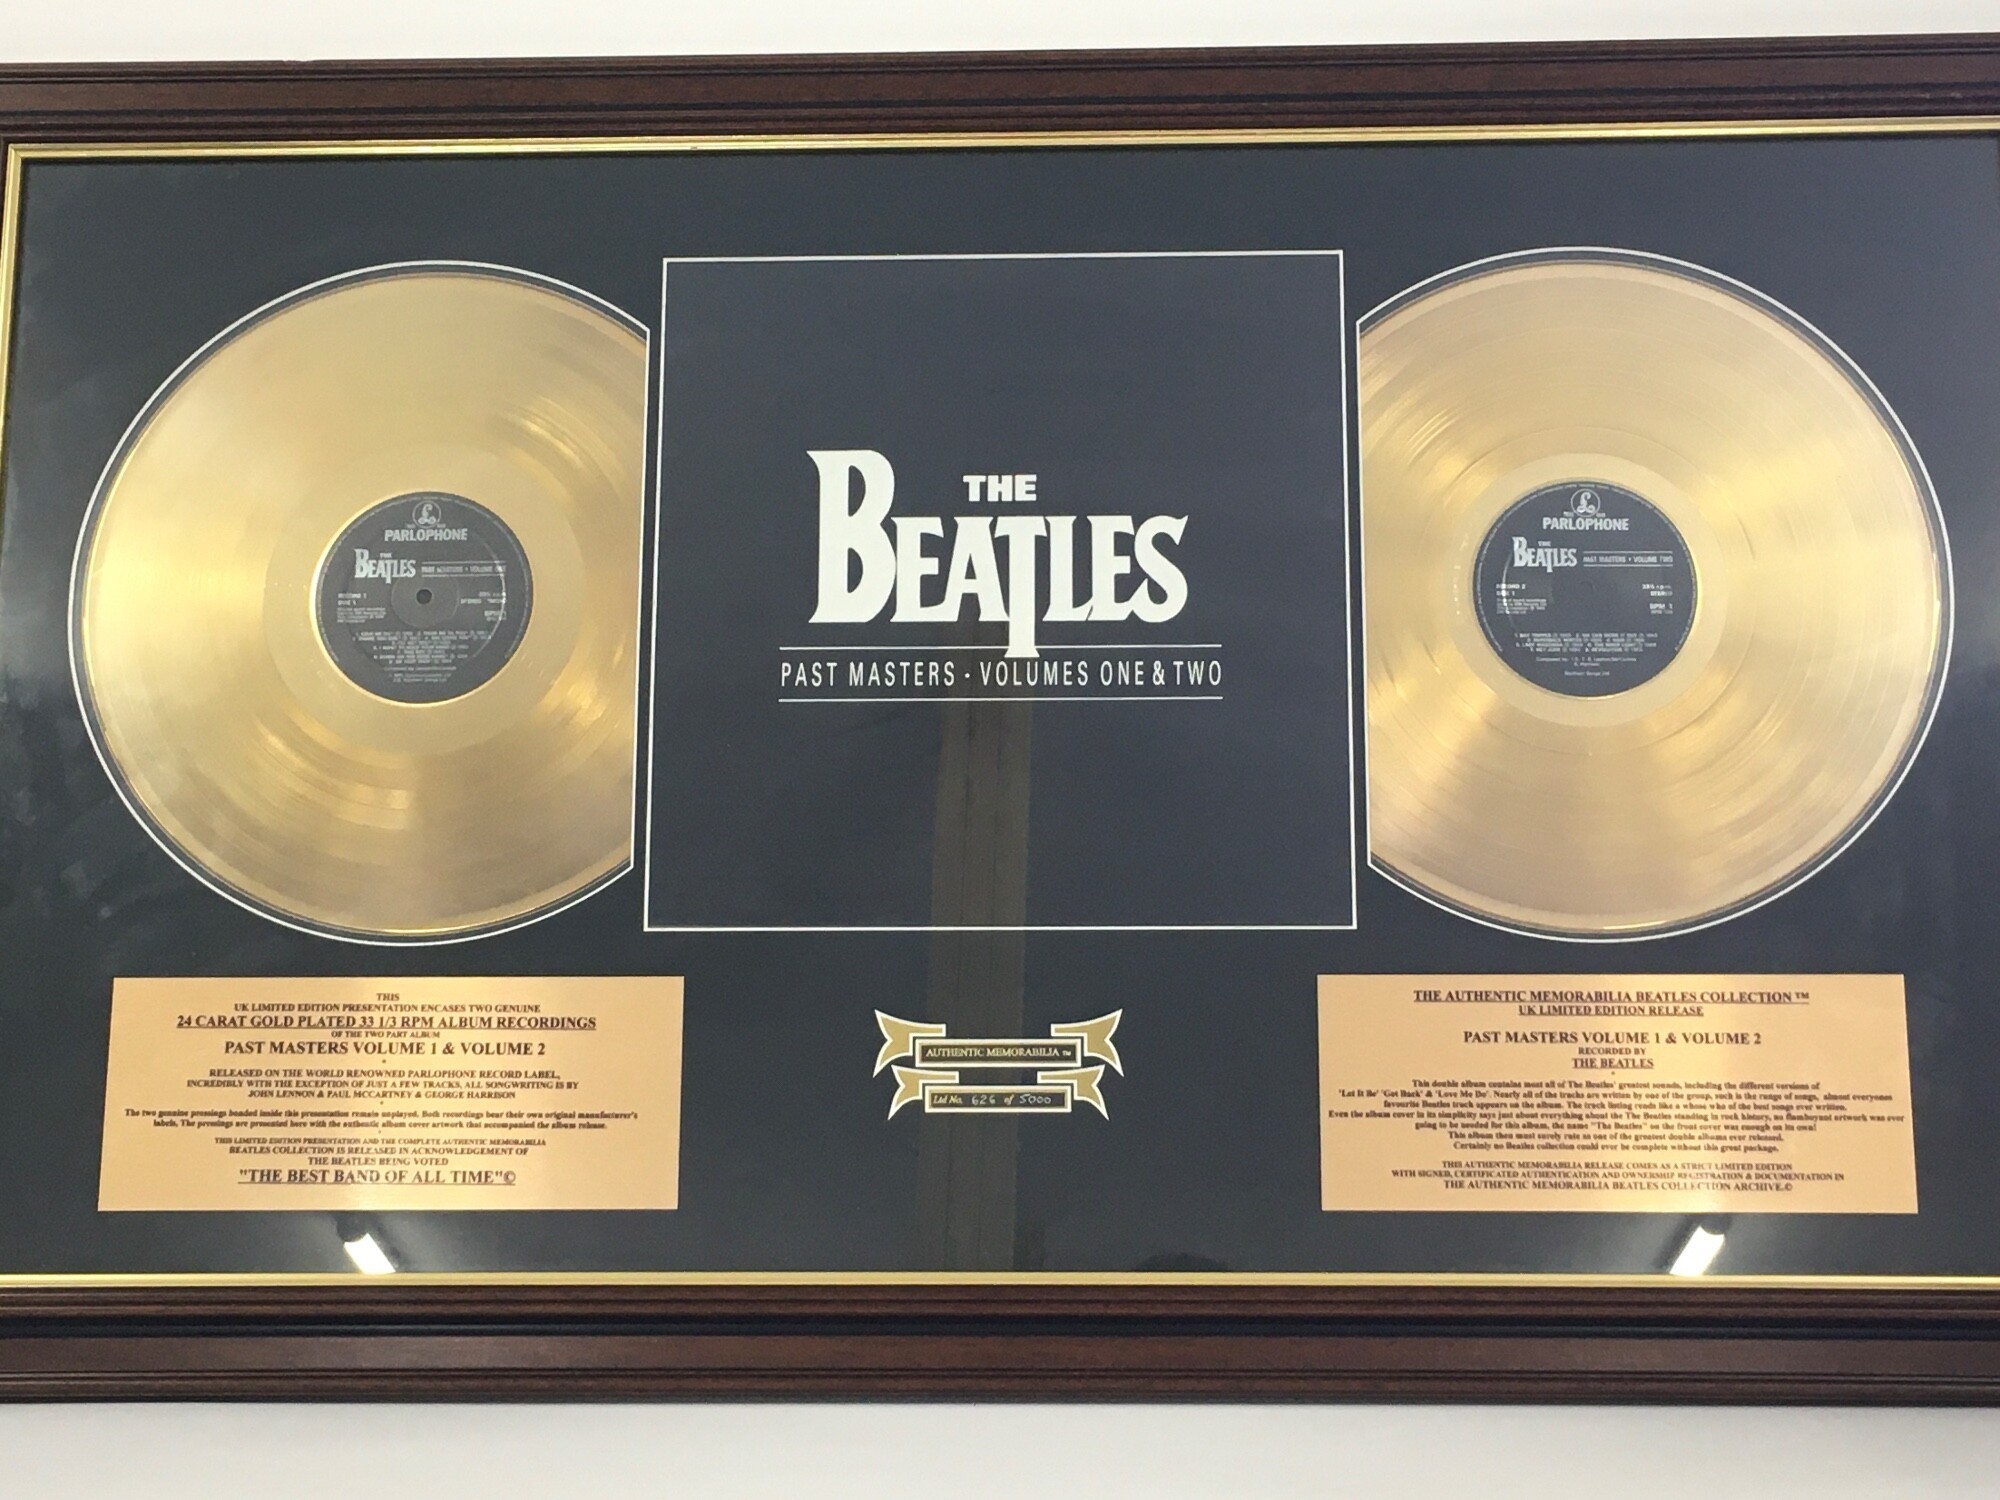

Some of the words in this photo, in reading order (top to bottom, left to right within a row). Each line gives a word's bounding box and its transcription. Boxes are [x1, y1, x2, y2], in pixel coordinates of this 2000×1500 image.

[962, 474, 1037, 502] THE
[1542, 517, 1629, 530] PARLOPHONE
[384, 528, 468, 542] PARLOPHONE
[806, 449, 1188, 658] BEATLES
[1512, 536, 1578, 573] BEATLES
[354, 548, 416, 584] BEATLES
[781, 662, 838, 687] PAST
[848, 661, 956, 687] MASTERS
[979, 660, 1090, 686] VOLUMES
[1100, 660, 1145, 686] ONE
[1152, 661, 1166, 686] &
[1173, 660, 1222, 686] TWO
[1413, 991, 1442, 1001] THE
[1444, 991, 1527, 1001] AUTHENTIC
[1529, 991, 1632, 1002] MEMORABILIA
[1635, 992, 1697, 1002] BEATLES
[1699, 992, 1792, 1002] COLLECTION
[233, 1004, 249, 1012] UK
[250, 1004, 296, 1012] LIMITED
[297, 1004, 340, 1012] EDITION
[341, 1004, 418, 1012] PRESENTATION
[420, 1004, 466, 1012] ENCASES
[469, 1004, 493, 1012] TWO
[494, 1004, 541, 1012] GENUINE
[1518, 1006, 1537, 1015] UK
[1539, 1006, 1592, 1015] LIMITED
[1594, 1006, 1646, 1015] EDITION
[1648, 1006, 1704, 1016] RELEASE
[176, 1016, 192, 1027] 24
[194, 1016, 245, 1027] CARAT
[249, 1016, 294, 1027] GOLD
[297, 1016, 356, 1027] PLATED
[358, 1016, 374, 1027] 33
[379, 1017, 397, 1027] 1/3
[400, 1017, 434, 1028] RPM
[438, 1017, 492, 1028] ALBUM
[496, 1017, 596, 1028] RECORDINGS
[1463, 1032, 1501, 1043] PAST
[1504, 1032, 1579, 1043] MASTERS
[1582, 1032, 1650, 1044] VOLUME
[1655, 1032, 1660, 1044] 1
[1665, 1032, 1677, 1044] &
[1682, 1033, 1750, 1044] VOLUME
[1753, 1033, 1762, 1044] 2
[224, 1042, 262, 1054] PAST
[269, 1042, 349, 1054] MASTERS
[353, 1042, 426, 1054] VOLUME
[431, 1043, 436, 1054] 1
[442, 1043, 455, 1054] &
[460, 1043, 534, 1055] VOLUME
[537, 1043, 546, 1055] 2
[926, 1048, 984, 1057] AUTHENTIC
[987, 1048, 1059, 1057] MEMORABILIA
[1573, 1059, 1597, 1068] THE
[1600, 1059, 1654, 1068] BEATLES
[208, 1069, 263, 1077] RELEASED
[305, 1070, 344, 1078] WORLD
[346, 1070, 406, 1078] RENOWNED
[407, 1070, 476, 1078] PARLOPHONE
[478, 1070, 522, 1079] RECORD
[524, 1071, 561, 1079] LABEL,
[186, 1080, 244, 1088] INCREDIBLY
[246, 1080, 272, 1088] WITH
[274, 1080, 293, 1088] THE
[294, 1080, 350, 1088] EXCEPTION
[350, 1080, 364, 1088] OF
[365, 1080, 388, 1088] JUST
[465, 1081, 482, 1089] ALL
[485, 1081, 554, 1089] SONGWRITING
[554, 1081, 565, 1089] IS
[566, 1081, 579, 1089] BY
[466, 1091, 516, 1099] HARRISON
[933, 1095, 947, 1104] Ltd
[971, 1094, 996, 1104] 626
[1004, 1095, 1013, 1106] of
[1019, 1094, 1052, 1104] 5000
[239, 1169, 283, 1182] "THE
[286, 1169, 330, 1182] BEST
[333, 1170, 380, 1182] BAND
[384, 1170, 407, 1182] OF
[412, 1170, 445, 1182] ALL
[1444, 1181, 1466, 1189] THE
[1467, 1181, 1530, 1189] AUTHENTIC
[1531, 1181, 1610, 1190] MEMORABILIA
[1612, 1182, 1659, 1190] BEATLES
[1660, 1182, 1732, 1190] COLLECTION
